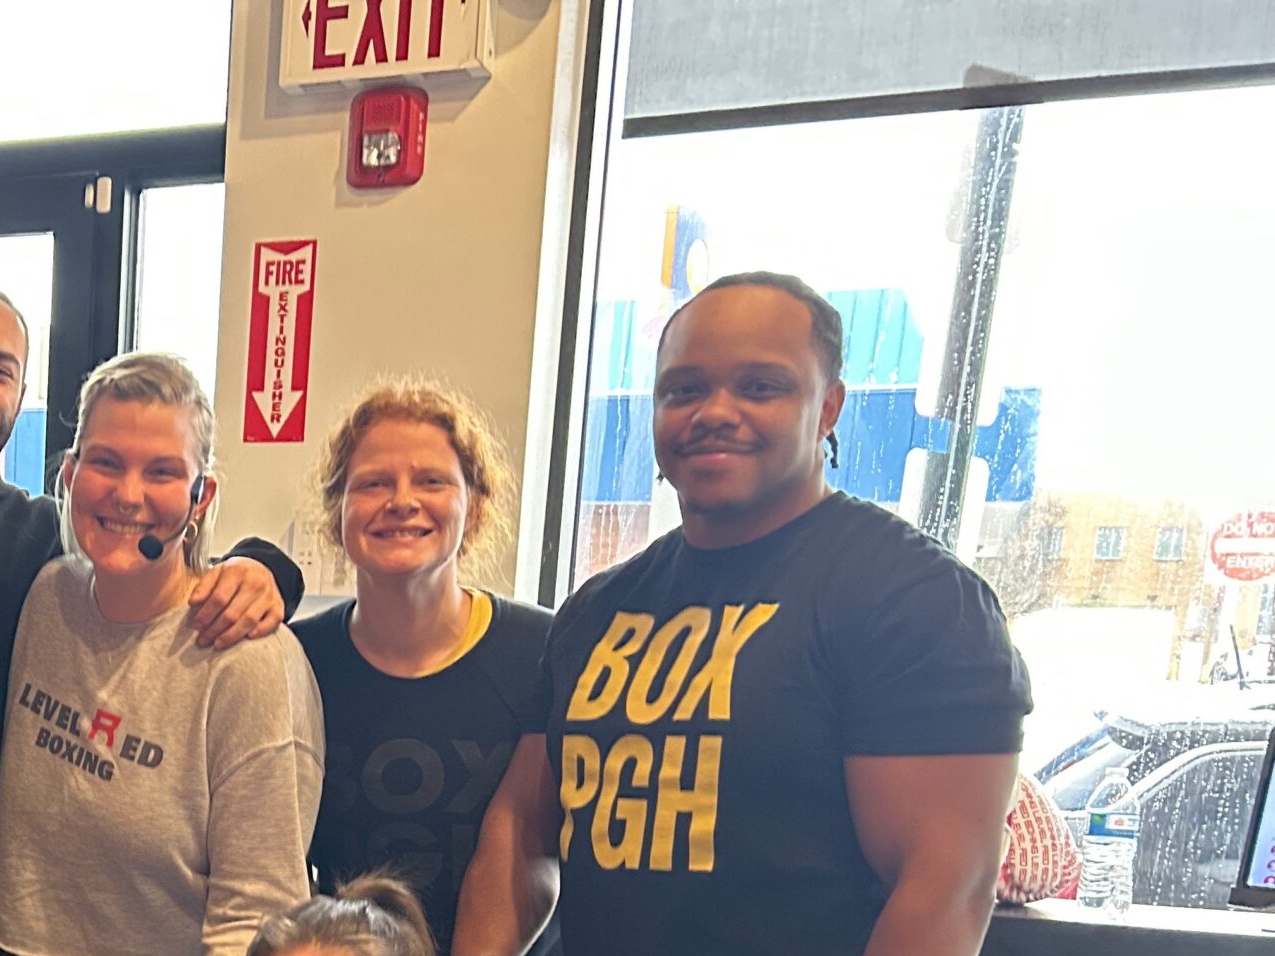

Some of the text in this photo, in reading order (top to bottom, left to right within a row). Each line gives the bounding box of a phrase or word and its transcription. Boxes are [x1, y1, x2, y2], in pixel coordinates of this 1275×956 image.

[312, 0, 444, 71] EXIT
[264, 258, 307, 288] FIRE
[269, 290, 289, 425] EXTINGUISHER
[566, 602, 780, 725] BOX
[19, 683, 81, 737] LEVEL
[35, 727, 116, 782] BOXING
[559, 733, 723, 873] PGH
